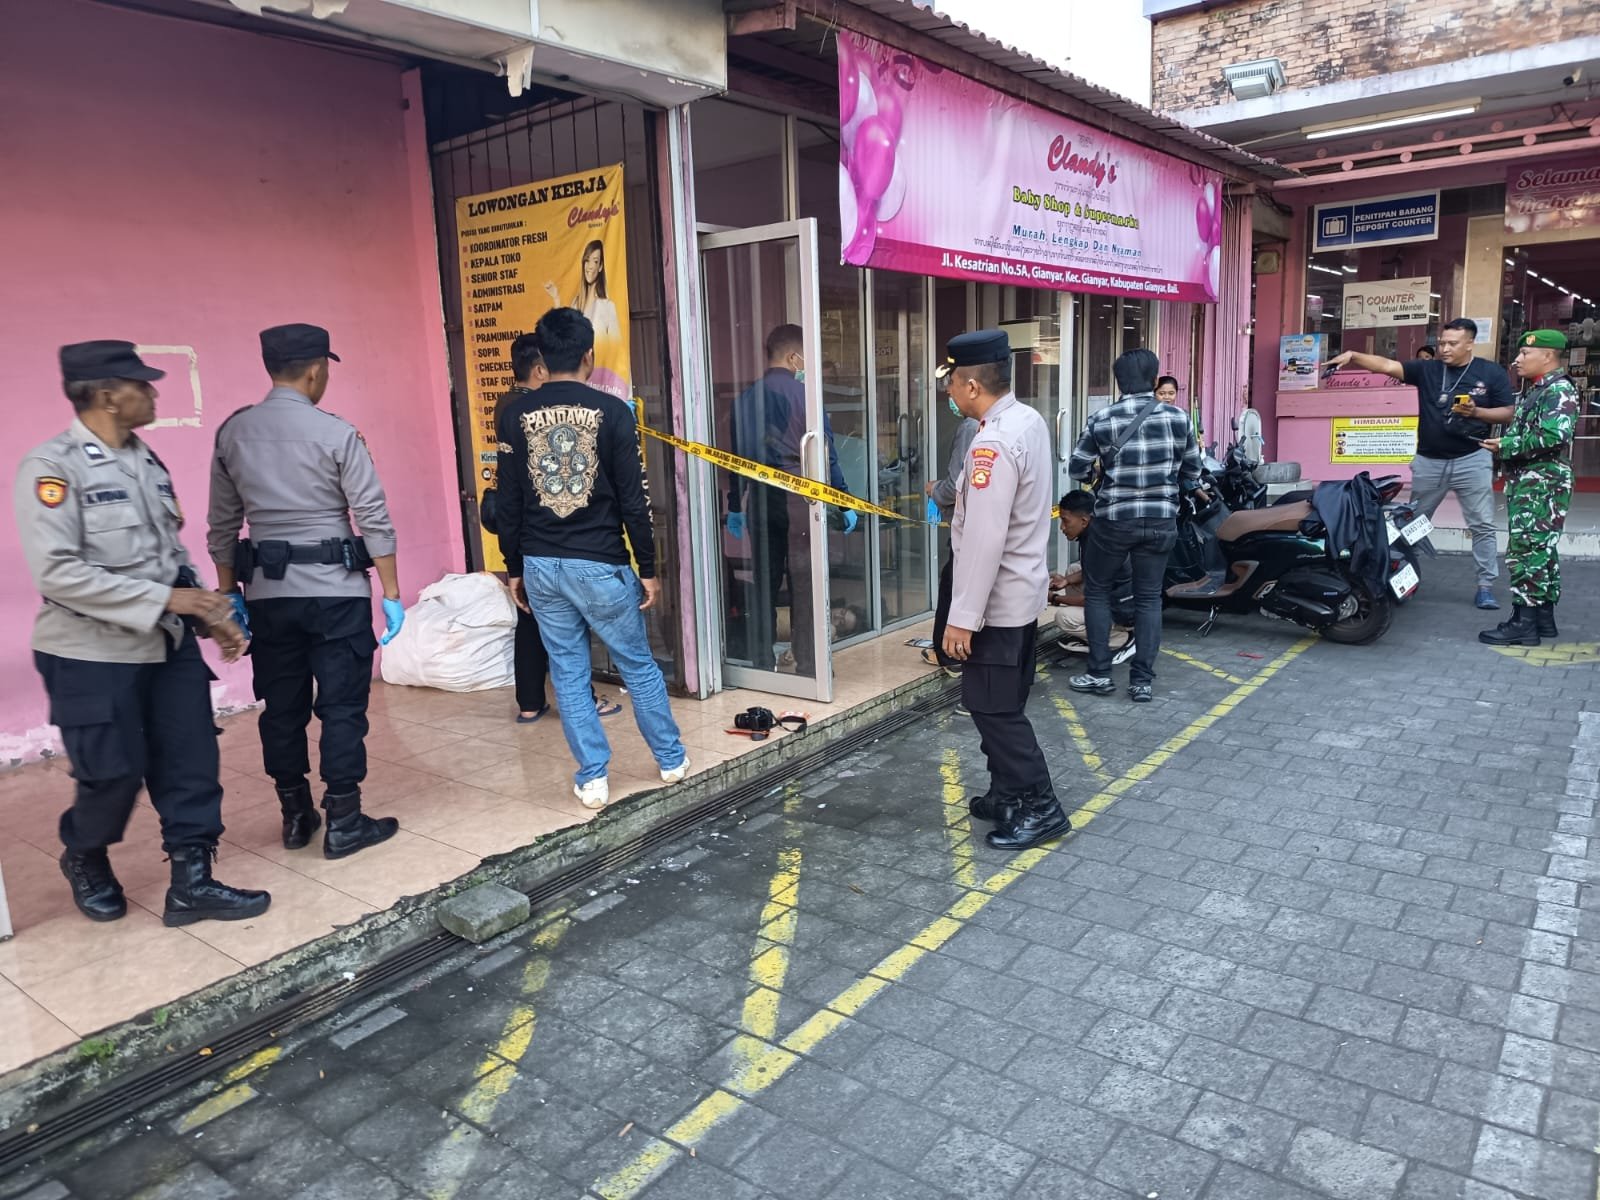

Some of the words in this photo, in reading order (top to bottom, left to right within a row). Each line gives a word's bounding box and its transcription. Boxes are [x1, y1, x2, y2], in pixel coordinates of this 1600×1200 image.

[1047, 134, 1117, 188] Clandy's
[1516, 166, 1600, 190] Selama
[468, 187, 549, 217] LOWONGAN
[551, 175, 608, 200] KERJA
[1013, 185, 1041, 211] Baby
[1043, 194, 1071, 217] Shop
[1074, 202, 1082, 217] &
[567, 200, 620, 228] Clandy's
[1355, 210, 1397, 222] PENITIPAN
[1399, 205, 1434, 216] BARANG
[1355, 222, 1390, 233] DEPOSIT
[1391, 217, 1432, 228] COUNTER
[470, 236, 520, 254] KOORDINATOR
[521, 231, 548, 245] FRESH
[1052, 234, 1089, 250] Lengkap
[1093, 240, 1109, 251] Dan
[470, 256, 499, 269] KEPALA
[501, 252, 521, 264] TOKO
[471, 270, 498, 284] SENIOR
[499, 268, 518, 280] STAF
[954, 255, 1000, 273] Kesatrian
[1001, 262, 1031, 279] No.5A,
[1032, 266, 1064, 283] Gianyar,
[1065, 271, 1081, 284] Kec.
[1082, 272, 1110, 288] Gianyar,
[1110, 277, 1144, 292] Kabupaten
[472, 283, 525, 299] ADMINISTRASI
[1366, 292, 1415, 306] COUNTER
[474, 302, 503, 314] SATPAM
[1378, 304, 1398, 313] Virtual
[1398, 304, 1425, 312] Member
[475, 317, 497, 328] KASIR
[478, 347, 500, 358] SOPIR
[481, 377, 498, 387] STAF
[523, 407, 602, 431] PANDAWA
[705, 448, 730, 462] DILARANG
[731, 456, 757, 471] MELINTAS
[773, 471, 789, 483] GARIS
[791, 477, 810, 488] POLISI
